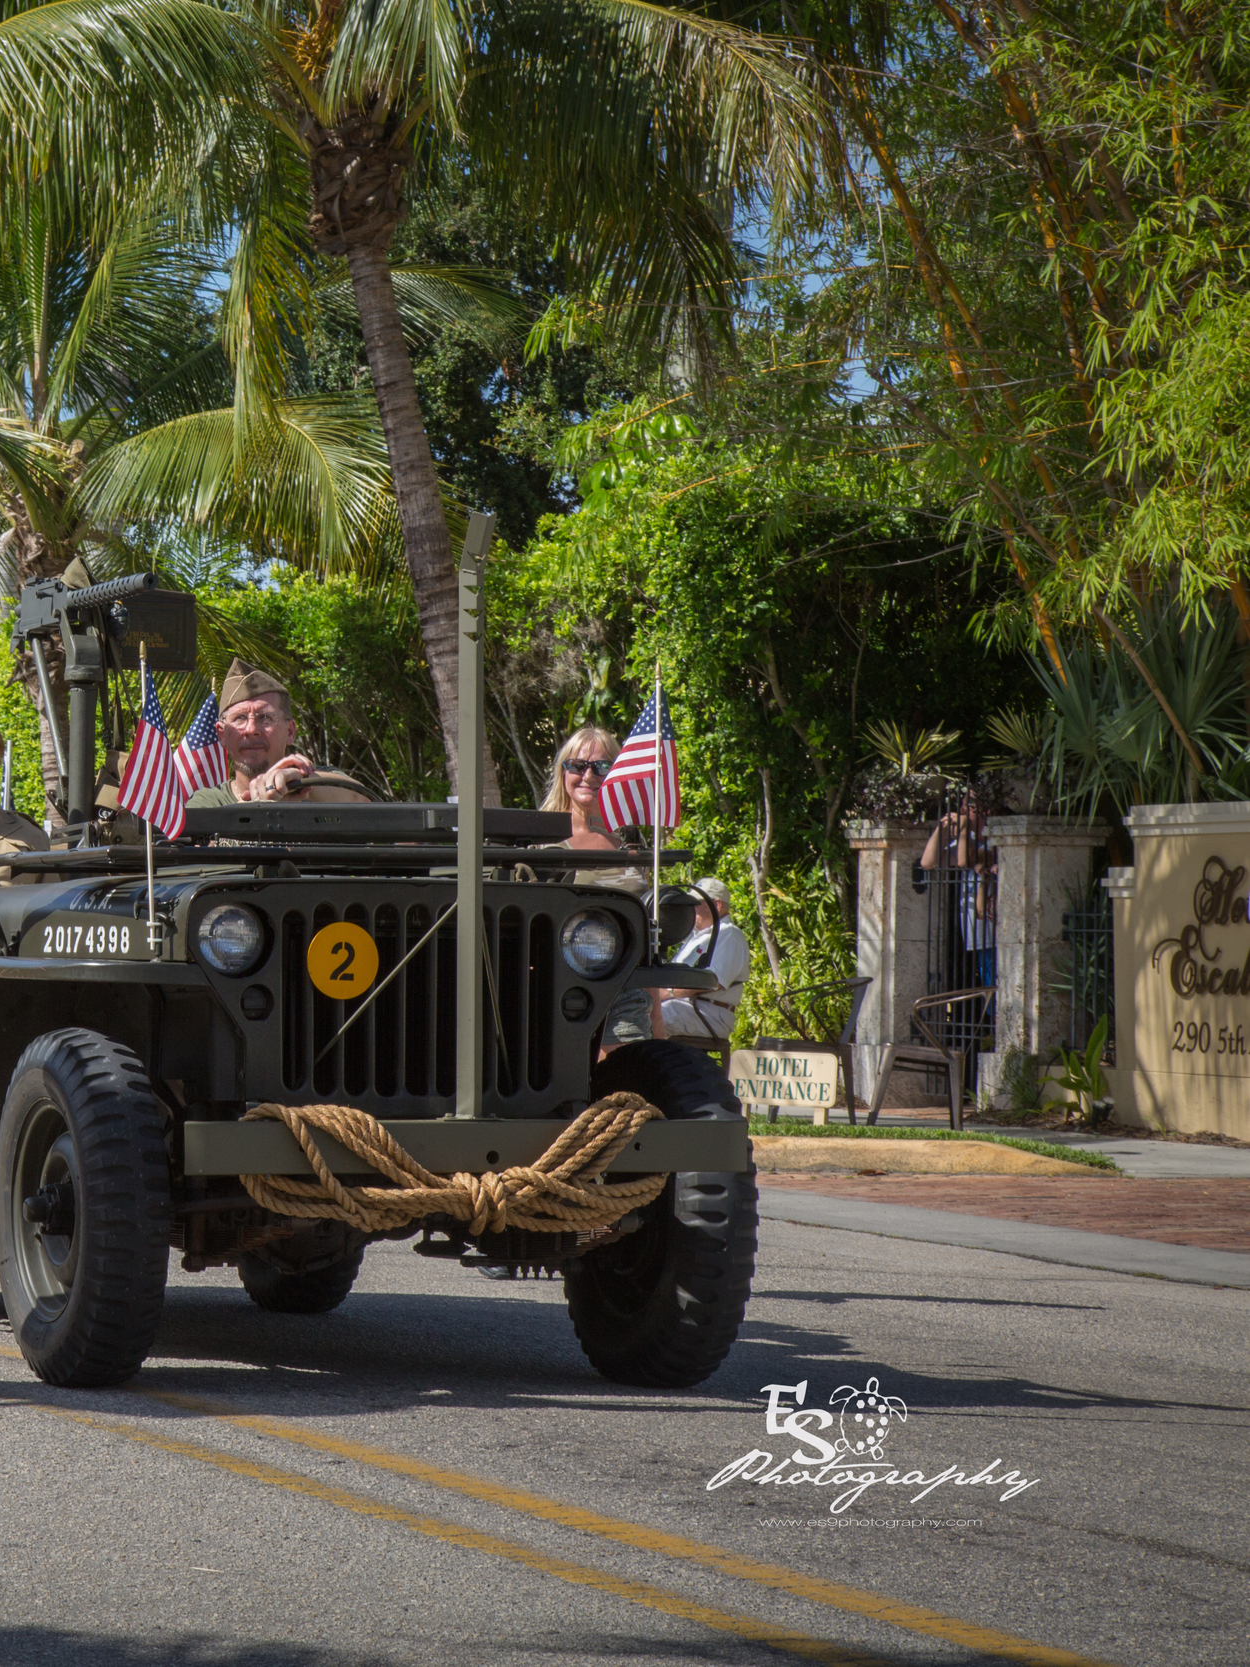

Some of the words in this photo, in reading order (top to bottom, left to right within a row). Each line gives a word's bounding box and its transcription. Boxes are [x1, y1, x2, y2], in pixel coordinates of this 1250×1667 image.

[69, 889, 113, 910] U.S.A.
[43, 925, 130, 954] 20174398
[329, 941, 356, 982] 2
[1171, 1020, 1211, 1053] 290
[1216, 1023, 1246, 1056] 5th
[754, 1056, 813, 1078] HOTEL
[734, 1078, 831, 1102] ENTRANCE
